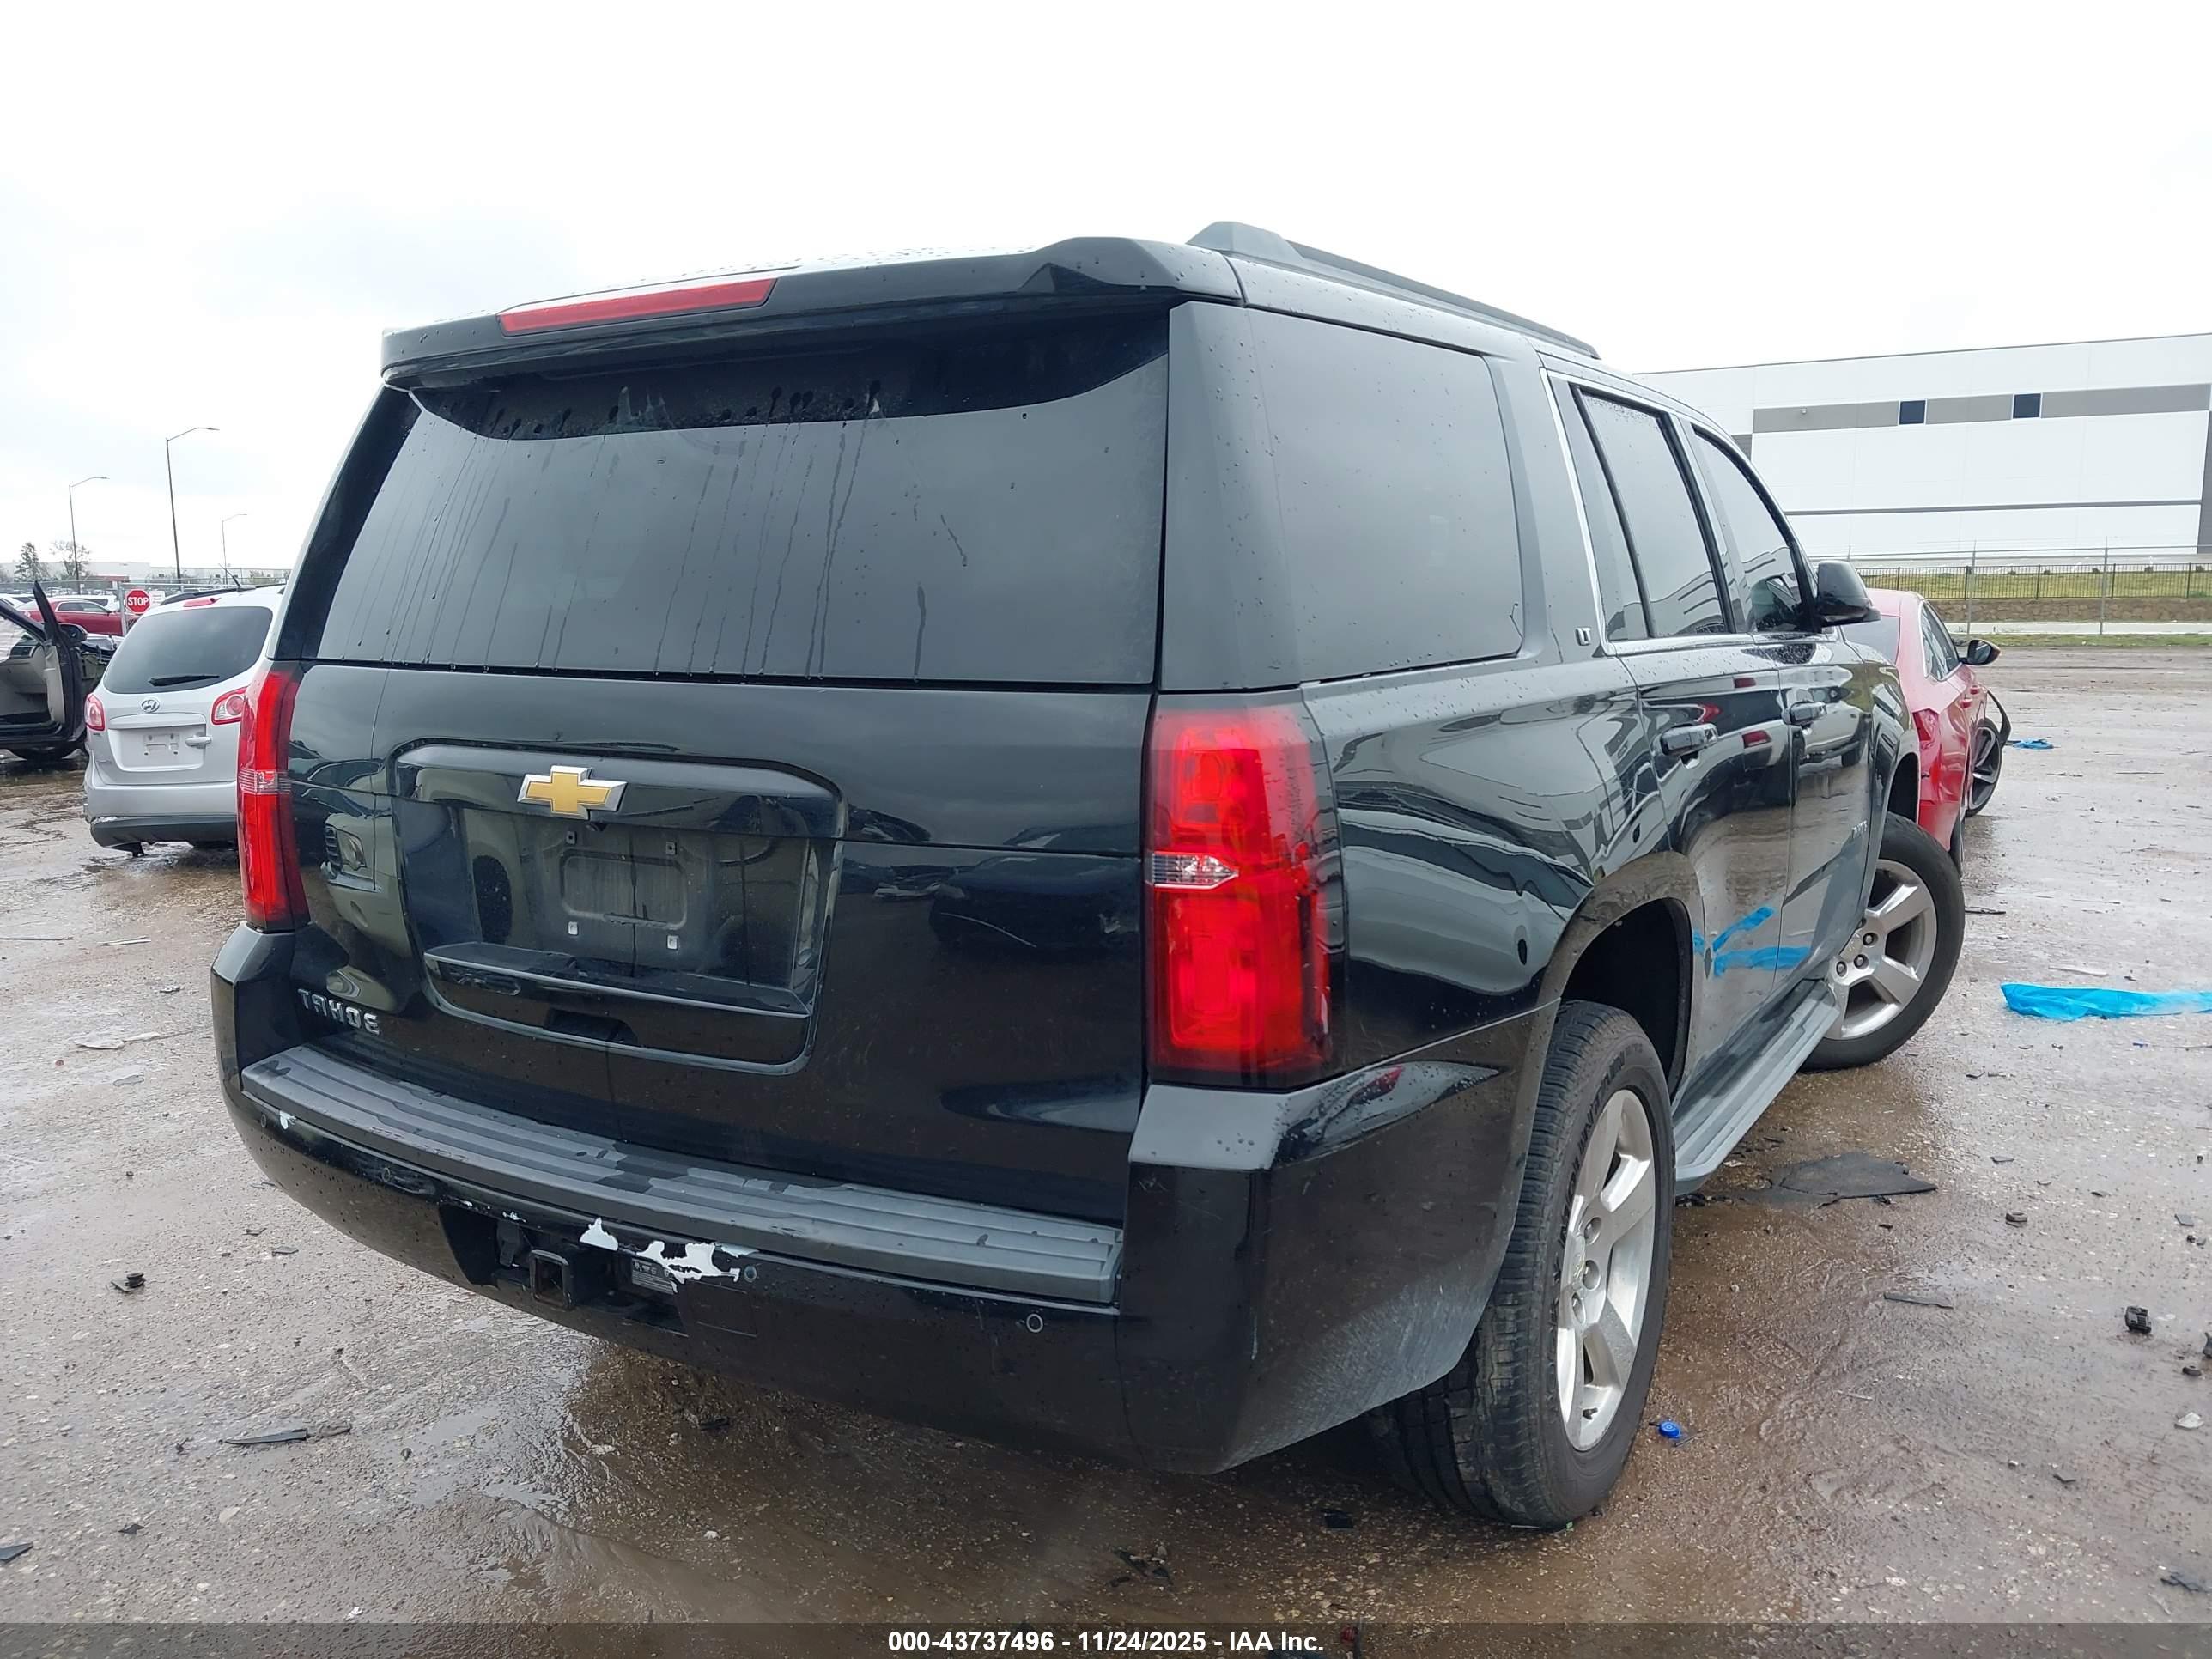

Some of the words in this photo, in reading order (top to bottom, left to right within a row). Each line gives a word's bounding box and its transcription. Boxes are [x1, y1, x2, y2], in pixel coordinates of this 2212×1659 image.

[128, 596, 149, 606] STOP
[1575, 628, 1591, 646] LT
[297, 988, 380, 1036] TAHOE
